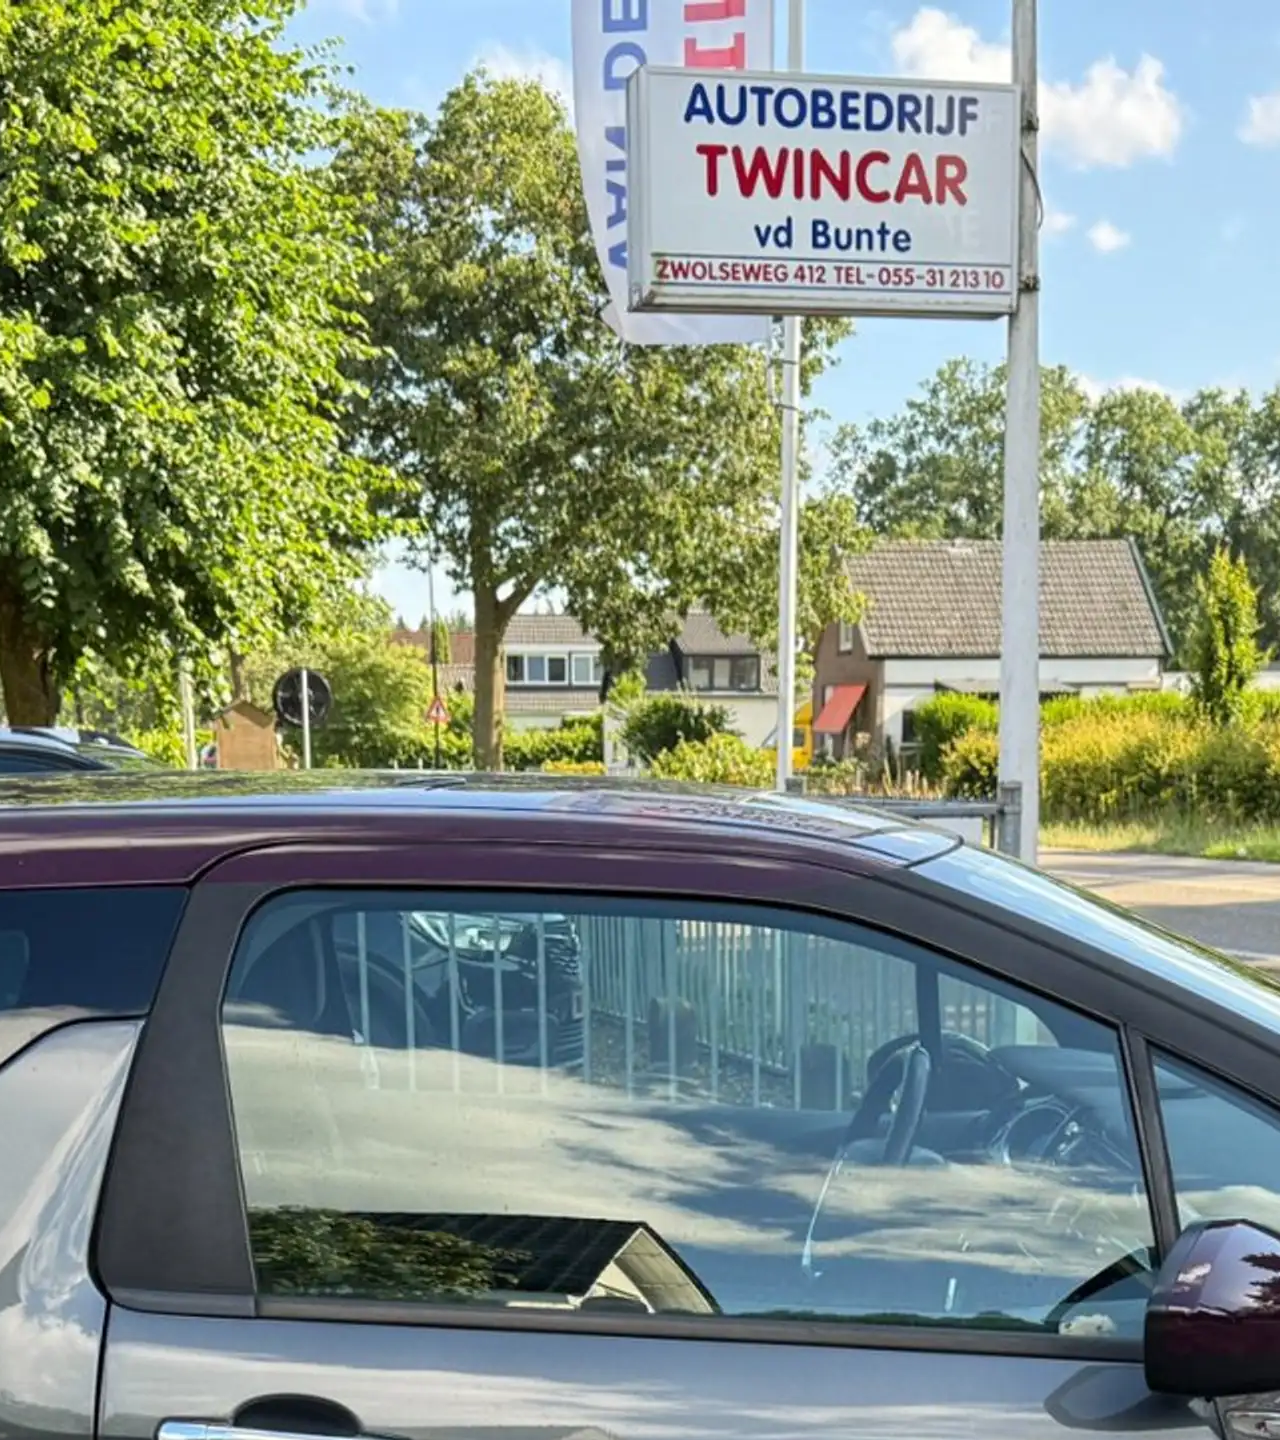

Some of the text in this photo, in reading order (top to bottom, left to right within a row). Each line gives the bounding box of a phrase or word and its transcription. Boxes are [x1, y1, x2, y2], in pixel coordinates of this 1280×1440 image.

[684, 82, 978, 136] AUTOBEDRIJF
[696, 144, 968, 206] TWINCAR
[754, 216, 793, 249] vd
[811, 218, 912, 252] Bunte
[656, 259, 790, 284] ZWOLSEWEG
[795, 265, 827, 285] 412
